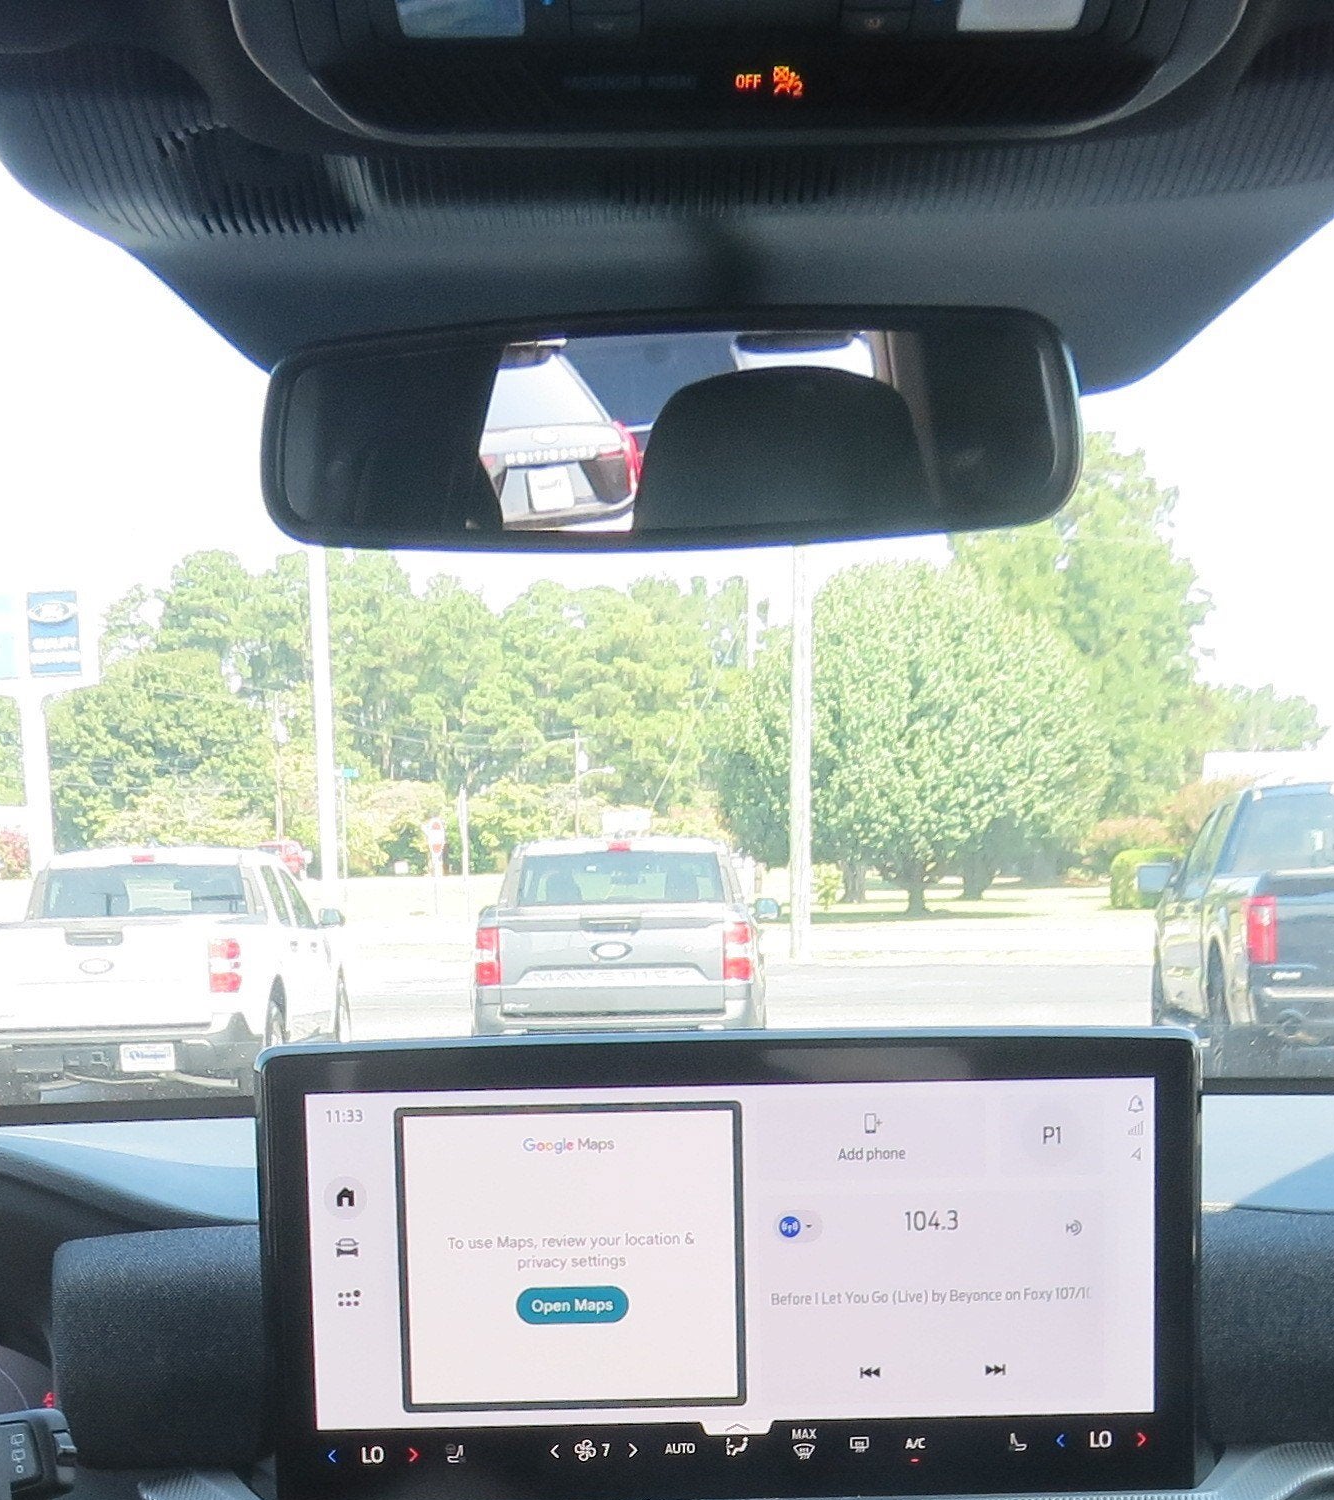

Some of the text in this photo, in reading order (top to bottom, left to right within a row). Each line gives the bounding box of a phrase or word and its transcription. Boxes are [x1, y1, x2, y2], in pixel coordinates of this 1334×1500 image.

[734, 73, 762, 89] OFF
[324, 1108, 364, 1124] 11:33
[1041, 1126, 1063, 1145] P1
[522, 1136, 615, 1155] Google Maps
[837, 1147, 906, 1164] Add phone
[904, 1209, 959, 1232] 104.3
[448, 1231, 696, 1253] To use Maps, review your location &
[516, 1253, 626, 1272] privacy settings
[770, 1291, 812, 1306] Before
[821, 1291, 842, 1305] Let
[844, 1290, 869, 1304] You
[871, 1290, 889, 1304] Go
[891, 1288, 929, 1306] (Live)
[931, 1289, 947, 1306] by
[949, 1288, 1003, 1306] Beyonce
[1005, 1290, 1021, 1302] on
[1023, 1287, 1053, 1304] Foxy
[531, 1297, 614, 1316] Open Maps
[792, 1428, 817, 1440] MAX
[1089, 1431, 1112, 1448] LO
[602, 1443, 610, 1457] 7
[664, 1442, 696, 1456] AUTO
[905, 1436, 926, 1450] A/C
[361, 1446, 384, 1464] LO
